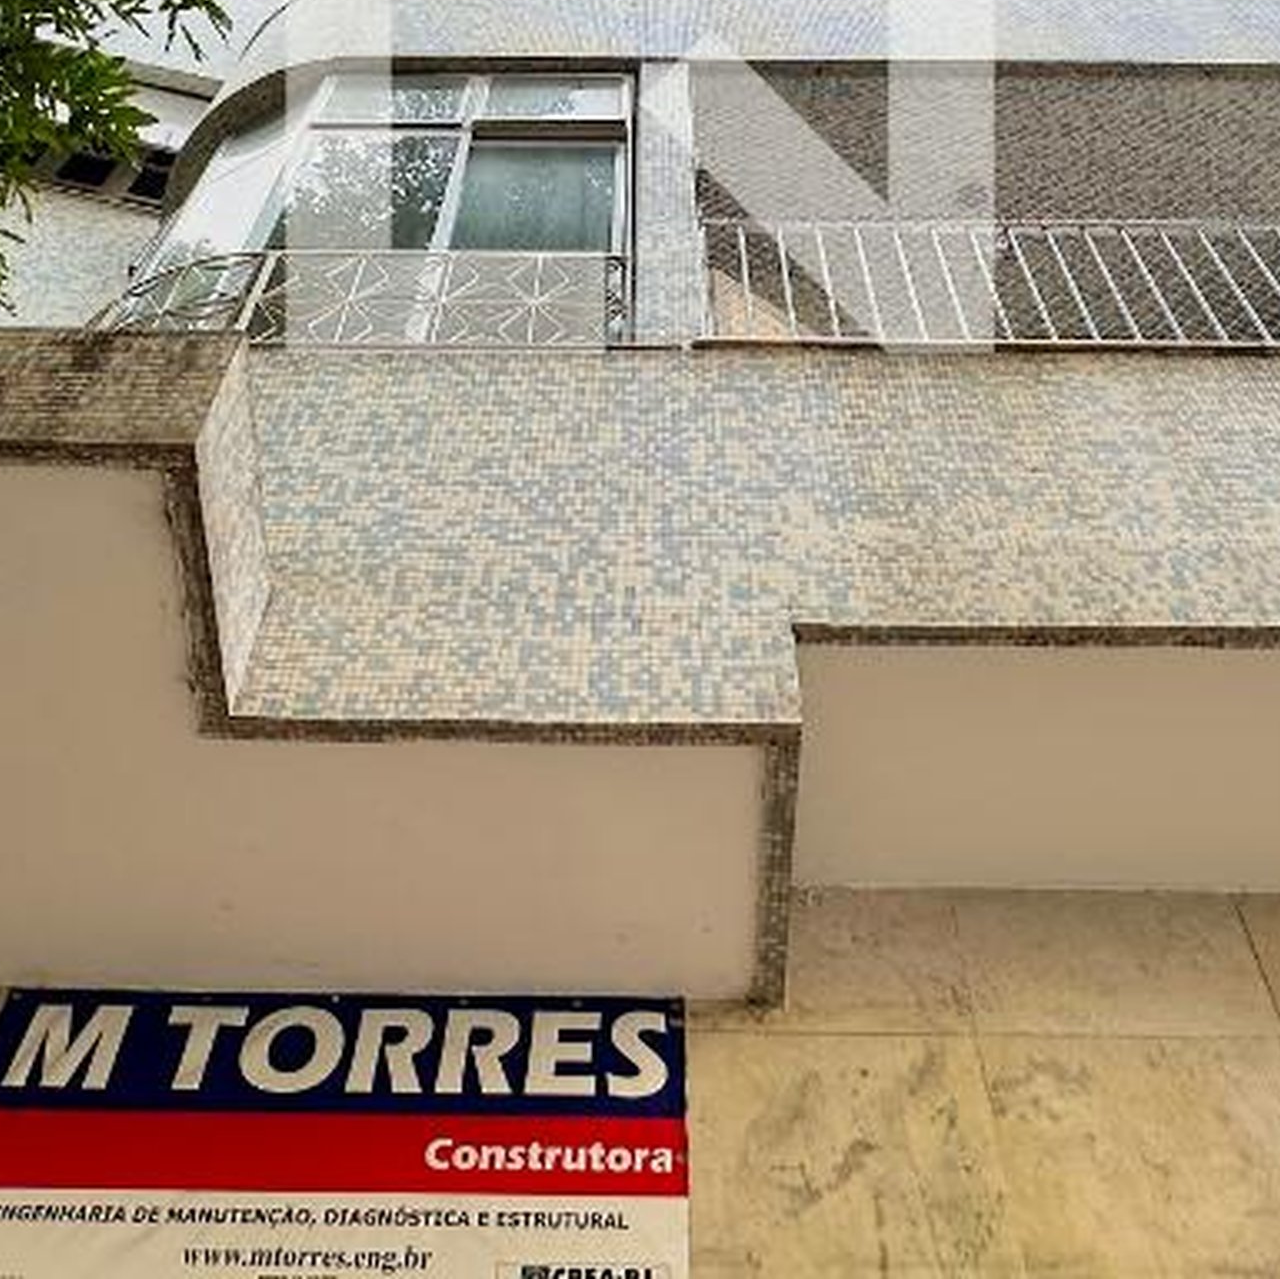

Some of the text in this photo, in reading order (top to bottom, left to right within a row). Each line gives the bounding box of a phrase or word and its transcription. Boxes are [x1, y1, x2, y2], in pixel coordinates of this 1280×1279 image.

[0, 1004, 670, 1099] M TORRES
[424, 1137, 674, 1174] Construtora
[132, 1206, 160, 1224] DE
[166, 1205, 317, 1226] MANUTENÇÃO,
[323, 1206, 471, 1227] DIAGNÓSTICA
[477, 1212, 490, 1227] E
[496, 1210, 630, 1231] ESTRUTURAL
[184, 1245, 432, 1273] www.mtorres.eng.br
